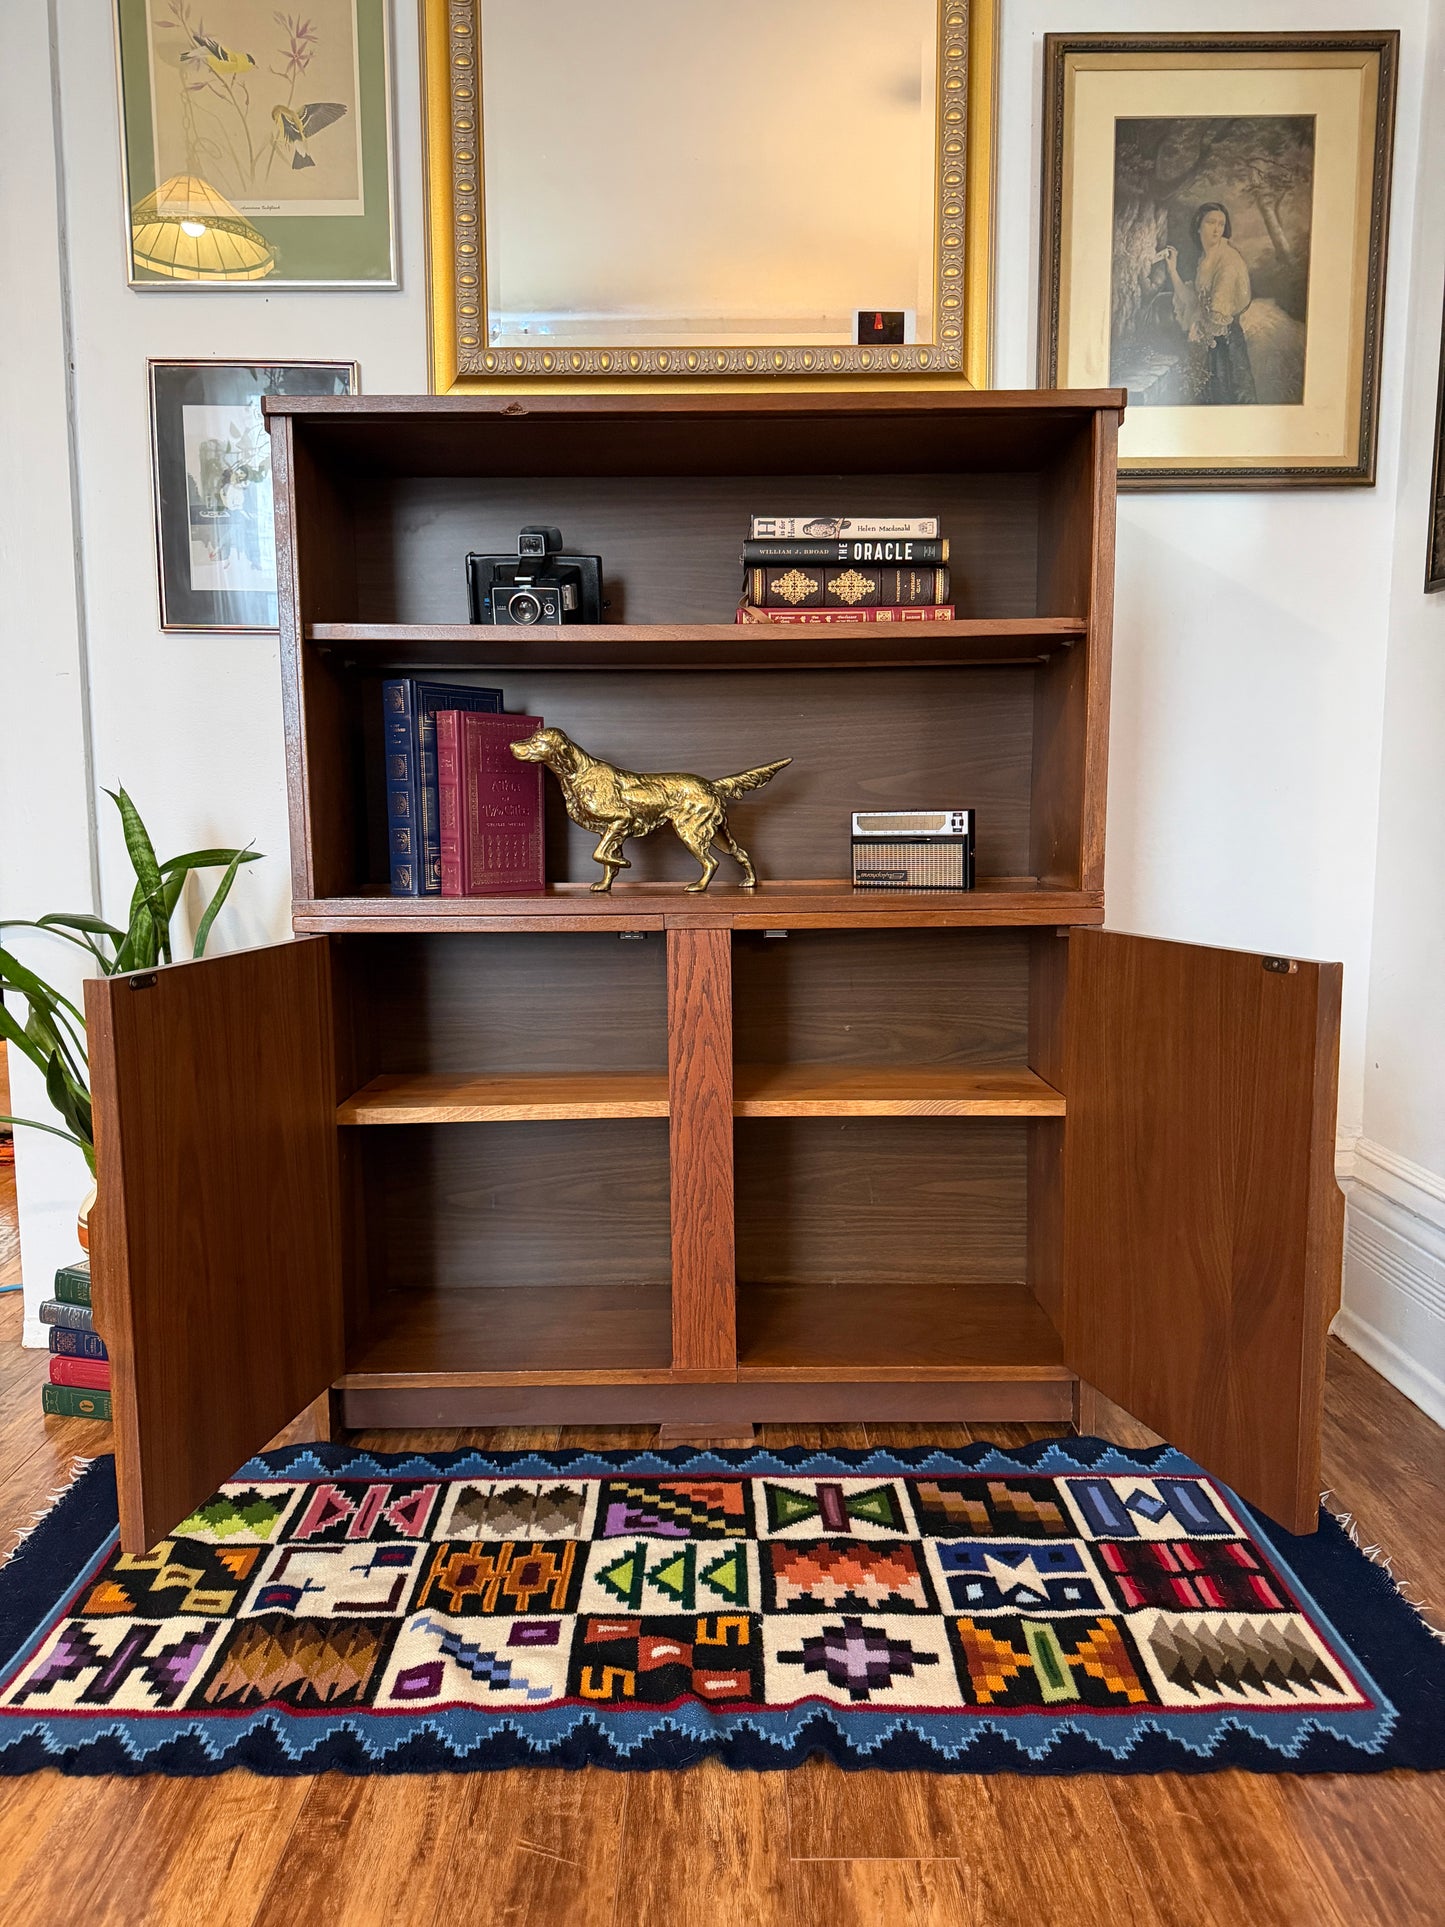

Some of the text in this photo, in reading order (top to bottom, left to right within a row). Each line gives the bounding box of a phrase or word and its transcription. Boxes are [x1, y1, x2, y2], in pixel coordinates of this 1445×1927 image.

[757, 519, 776, 537] H
[778, 519, 786, 529] for
[787, 518, 796, 538] Hawk
[857, 523, 911, 533] Helen Macdonald
[838, 542, 848, 560] THE
[853, 542, 914, 561] ORACLE
